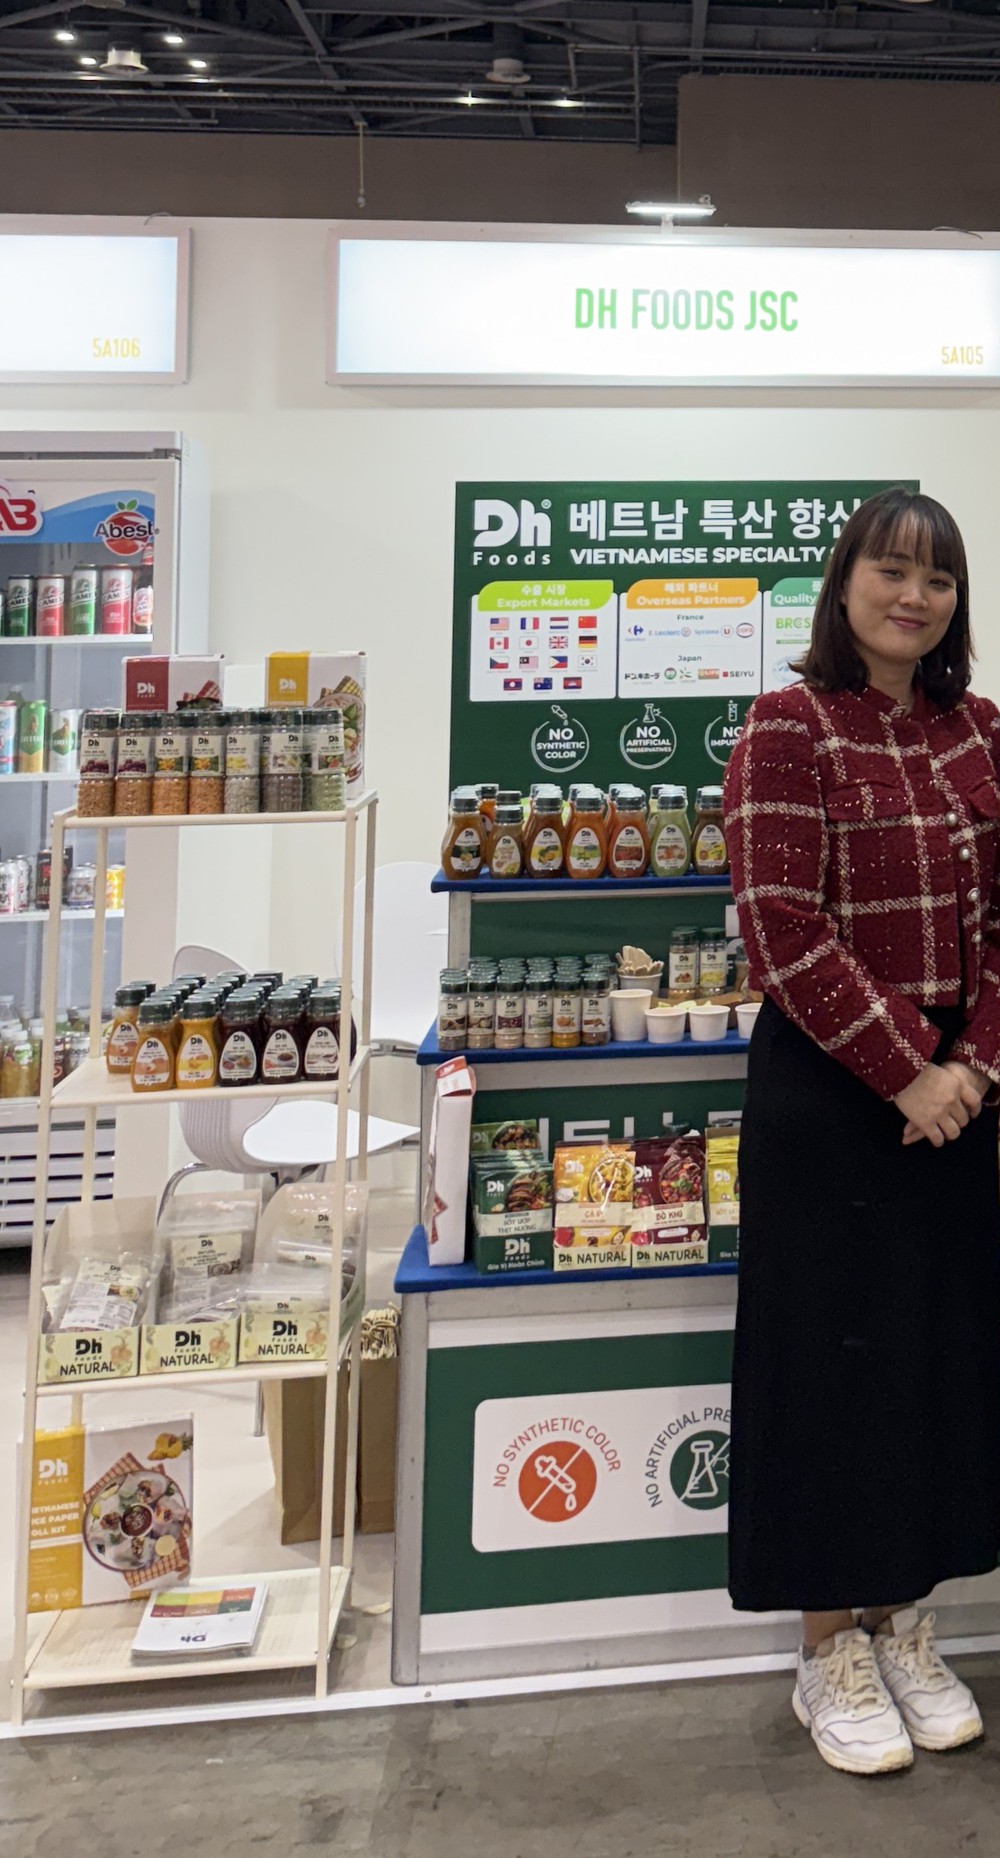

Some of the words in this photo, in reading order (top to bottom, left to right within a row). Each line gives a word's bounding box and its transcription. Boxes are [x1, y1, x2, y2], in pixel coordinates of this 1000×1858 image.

[574, 288, 617, 329] DH
[631, 289, 734, 331] FOODS
[744, 291, 798, 332] JSC
[92, 337, 141, 359] 5A106
[941, 346, 985, 365] 5A105
[474, 499, 551, 547] Dh
[569, 499, 689, 541] 베트남
[699, 499, 778, 541] 특산
[95, 521, 153, 539] Abest
[473, 551, 550, 566] Foods
[569, 547, 708, 565] VIETNAMESE
[712, 546, 826, 563] SPECIALTY
[497, 598, 537, 609] Export
[540, 597, 590, 607] Markets
[636, 595, 691, 606] Overseas
[694, 594, 746, 605] Partners
[774, 593, 816, 605] Quality
[678, 655, 703, 663] Japan
[137, 683, 155, 694] Dh
[549, 728, 574, 740] NO
[636, 726, 661, 738] NO
[723, 726, 744, 738] NO
[536, 741, 586, 751] SYNTHETIC
[626, 738, 672, 747] ARTIFICIAL
[711, 739, 737, 747] IMPUR
[545, 751, 577, 759] COLOR
[487, 1181, 505, 1193] Dh
[505, 1239, 530, 1255] Dh
[558, 1254, 573, 1263] Dh
[577, 1251, 627, 1264] NATURAL
[637, 1252, 650, 1260] Dh
[655, 1248, 704, 1261] NATURAL
[272, 1320, 298, 1337] Dh
[175, 1330, 202, 1347] Dh
[75, 1338, 102, 1356] Dh
[258, 1343, 310, 1356] NATURAL
[160, 1353, 214, 1367] NATURAL
[60, 1361, 115, 1377] NATURAL
[704, 1407, 732, 1424] PRE
[645, 1411, 701, 1479] ARTIFICIAL
[493, 1462, 510, 1488] NO
[503, 1417, 584, 1462] SYNTHETIC
[585, 1425, 621, 1472] COLOR
[39, 1458, 68, 1479] Dh
[645, 1482, 663, 1508] NO
[31, 1501, 80, 1514] IETNAMESE
[31, 1516, 46, 1525] ICE
[48, 1512, 80, 1523] PAPER
[31, 1528, 49, 1537] OLL
[51, 1525, 66, 1535] KIT
